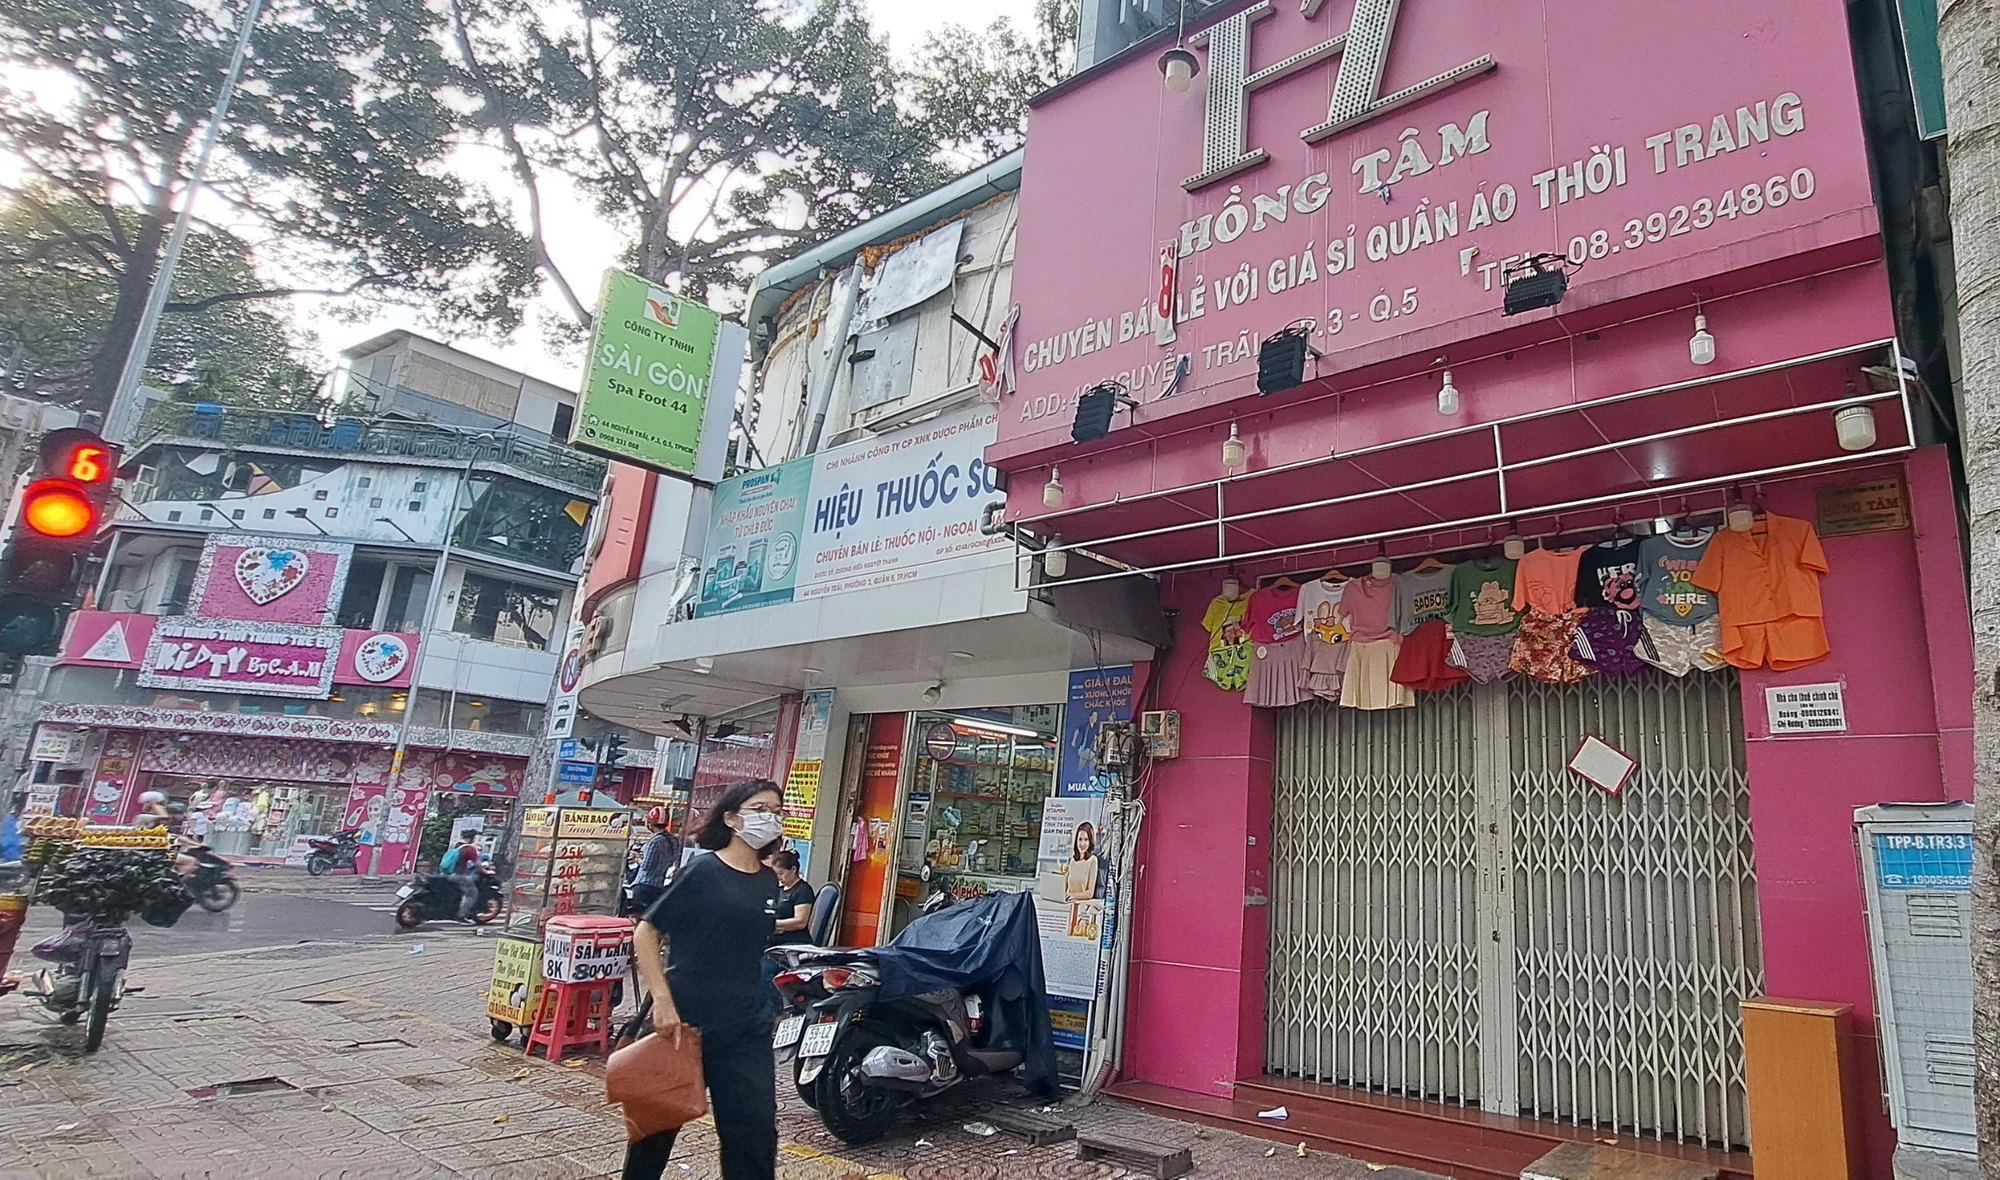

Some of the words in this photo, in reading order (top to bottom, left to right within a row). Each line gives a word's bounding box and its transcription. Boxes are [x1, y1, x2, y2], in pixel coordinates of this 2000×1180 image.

[1177, 172, 1333, 259] HỒNG
[1352, 110, 1492, 195] TÂM
[1567, 166, 1817, 263] 08.39234860
[1023, 316, 1114, 373] CHUYÊN
[1176, 274, 1206, 325] LẺ
[1214, 261, 1260, 311] VỚI
[1267, 241, 1318, 297] GIÁ
[1326, 225, 1357, 275] SỈ
[1366, 198, 1458, 263] QUẦN
[1466, 178, 1518, 232] ÁO
[1532, 145, 1628, 210] THỜI
[1645, 92, 1807, 174] TRANG
[624, 319, 652, 339] CÔNG
[653, 331, 667, 344] TY
[668, 336, 695, 355] TNHH
[600, 343, 642, 377] SÀI
[648, 362, 704, 400] GÒN
[1018, 386, 1068, 424] ADD:
[1201, 330, 1261, 370] TRÃI
[1368, 288, 1419, 323] Q.5
[607, 377, 634, 397] Spa
[638, 387, 667, 408] Foot
[670, 400, 689, 415] 44
[601, 419, 610, 428] 44
[826, 460, 839, 471] CHI
[840, 451, 866, 467] NHÁNH
[866, 444, 891, 459] CÔNG
[891, 441, 901, 453] TY
[901, 438, 913, 450] CP
[914, 434, 932, 447] XNK
[932, 424, 957, 441] DƯỢC
[958, 414, 983, 433] PHẨM
[70, 448, 101, 482] 6
[741, 473, 770, 490] PROSPAN
[813, 482, 864, 540] HIỆU
[876, 450, 960, 520] THUỐC
[815, 543, 850, 565] CHUYÊN
[850, 541, 870, 558] BÁN
[870, 538, 882, 555] LẺ:
[884, 528, 916, 551] THUỐC
[917, 528, 937, 547] NỘI
[943, 519, 978, 539] NGOẠI
[1664, 592, 1708, 605] HERE
[1067, 782, 1088, 793] MUA
[564, 811, 590, 824] BÁNH
[590, 814, 609, 824] BAO
[561, 846, 584, 859] 25k
[1886, 835, 1967, 850] TPP-B.TR3.3
[559, 865, 582, 878] 20k
[546, 959, 564, 979] 8K
[809, 1025, 832, 1041] 59-L2
